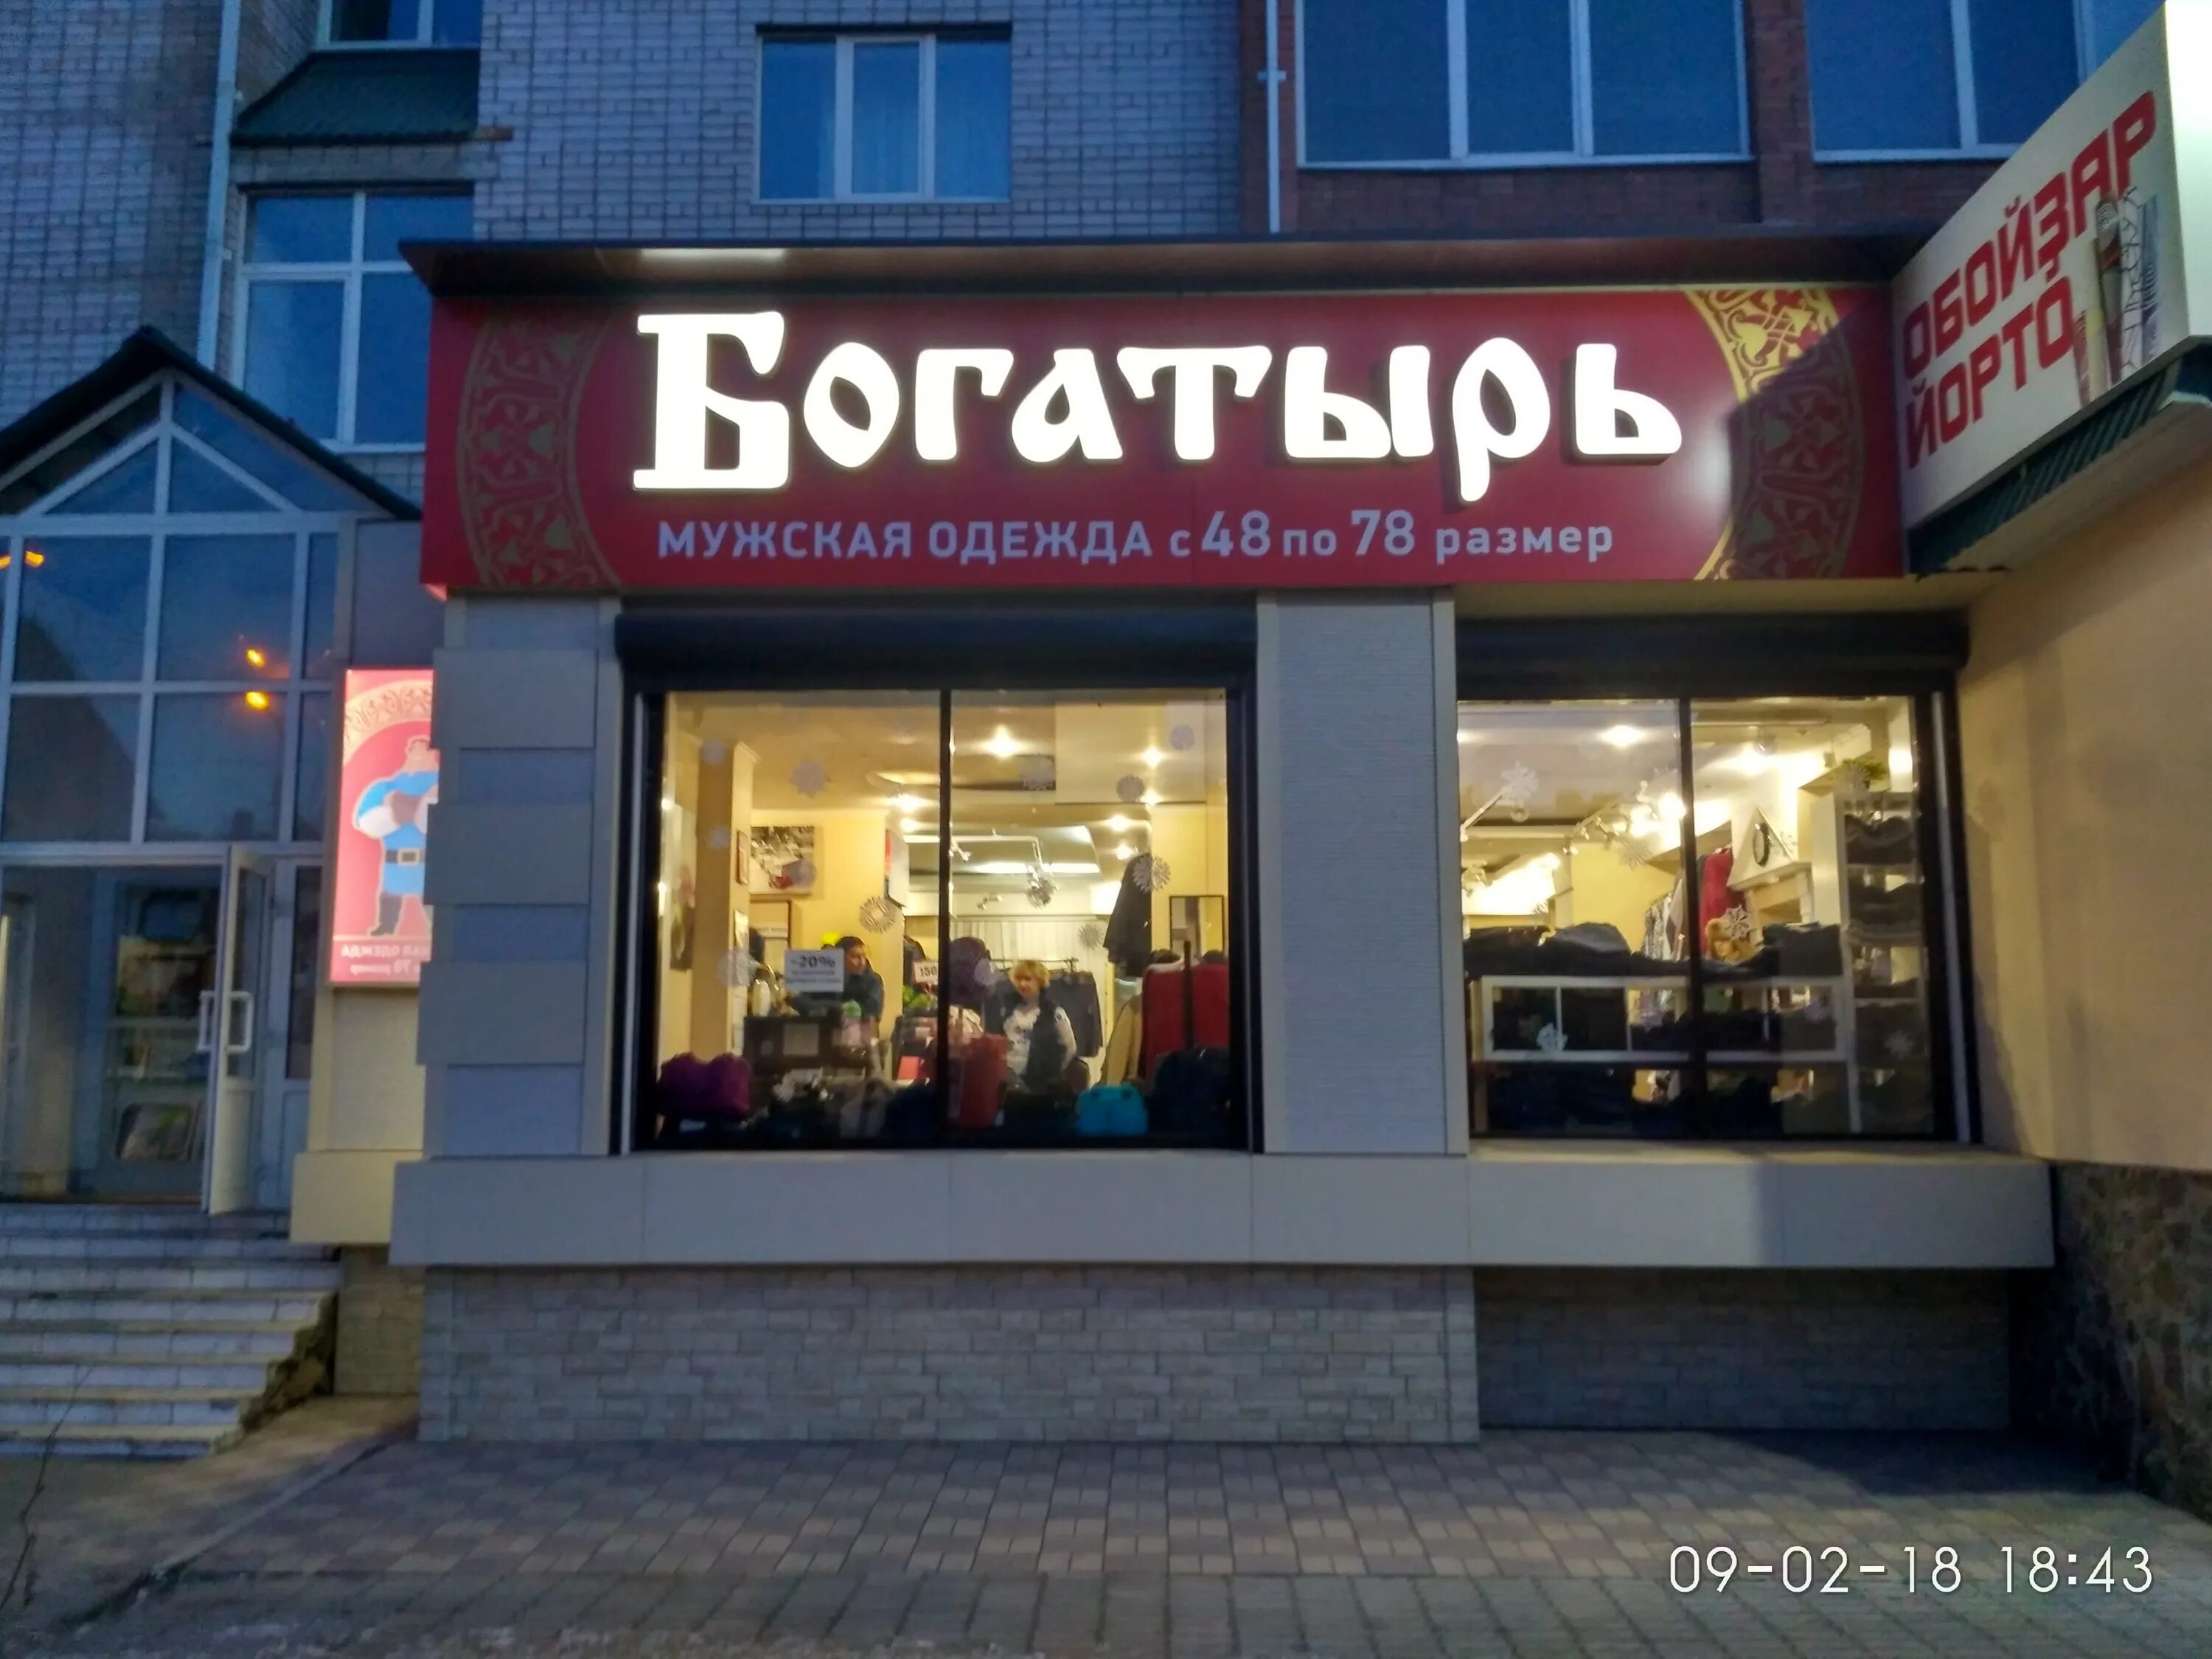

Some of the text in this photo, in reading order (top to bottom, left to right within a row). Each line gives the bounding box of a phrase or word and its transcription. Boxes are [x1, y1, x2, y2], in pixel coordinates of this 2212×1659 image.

[633, 311, 1682, 502] Богатырь
[1907, 276, 2073, 469] ЙОРТО
[658, 509, 1613, 564] МУЖСКАЯ ОДЕЖДА с 48 по 78 размер
